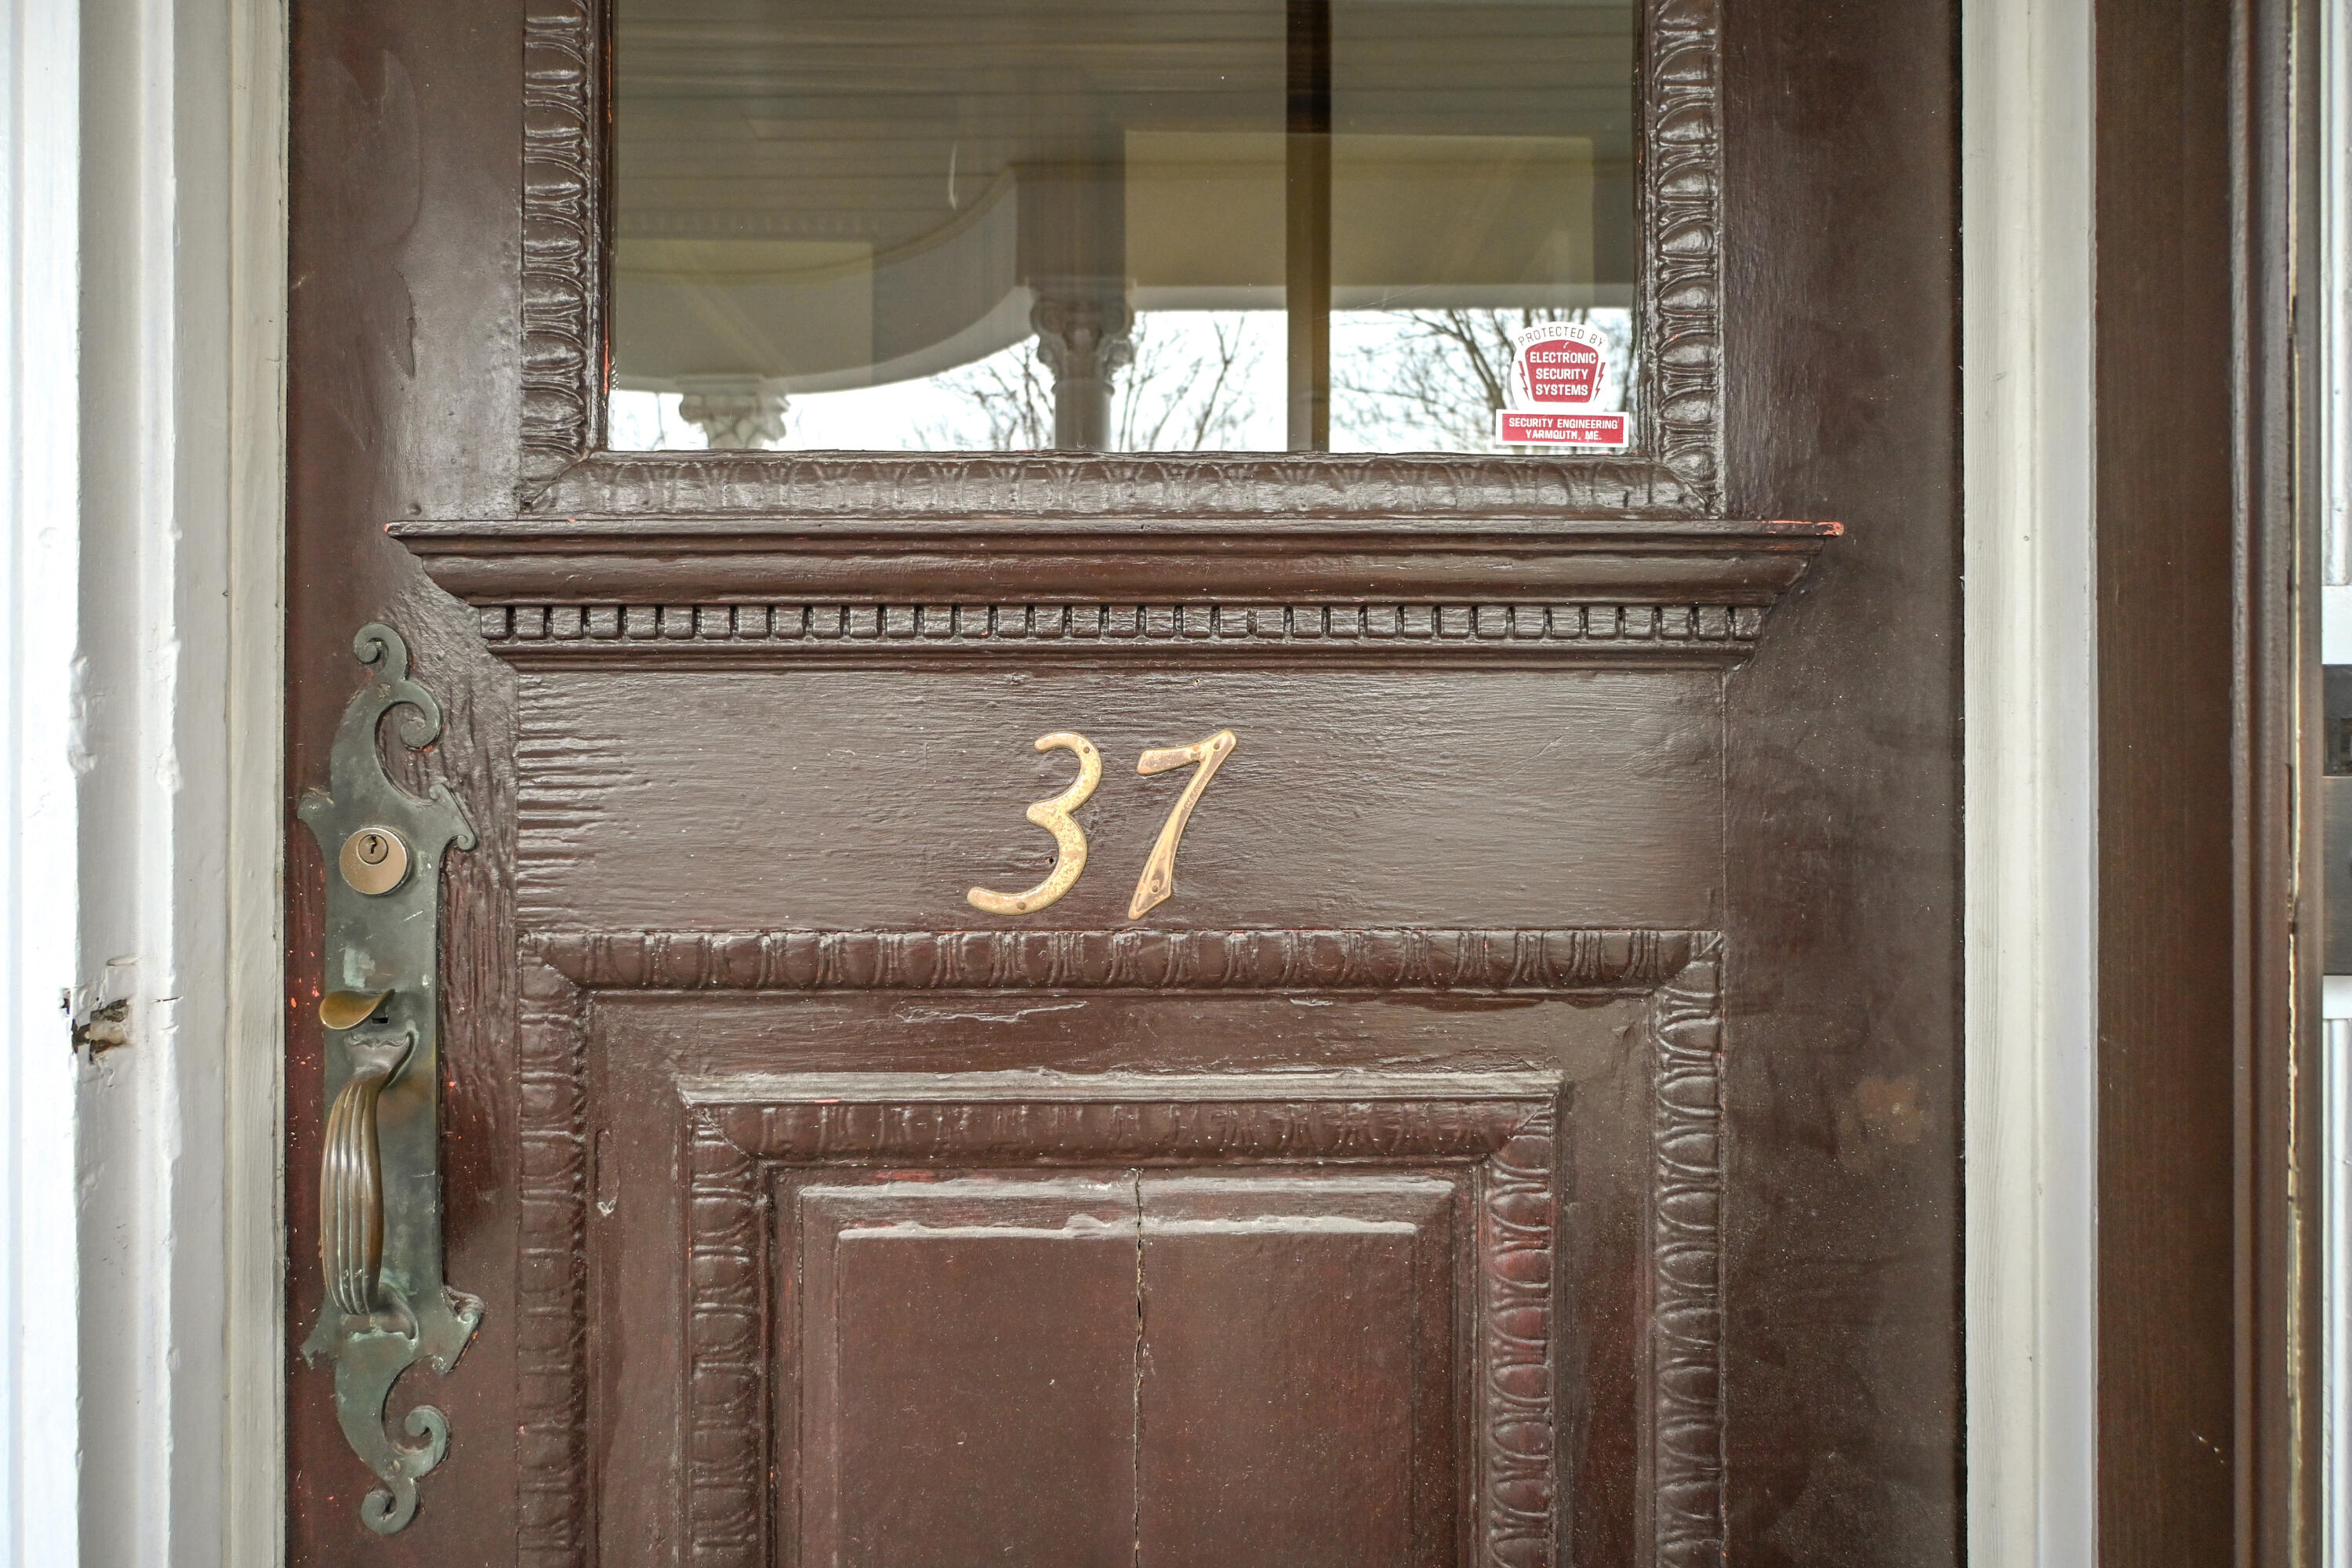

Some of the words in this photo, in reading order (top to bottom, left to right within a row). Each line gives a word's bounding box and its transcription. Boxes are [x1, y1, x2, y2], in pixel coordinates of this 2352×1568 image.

[1518, 326, 1584, 347] PROTECTED
[1589, 333, 1606, 347] BY
[1530, 351, 1597, 364] ELECTRONIC
[1535, 368, 1589, 380] SECURITY
[1535, 383, 1588, 396] SYSTEMS
[1508, 417, 1554, 428] SECURITY
[1557, 418, 1618, 430] ENGINEERING
[1525, 429, 1581, 441] YARMOUTH,
[1584, 430, 1602, 441] ME.
[966, 728, 1238, 920] 37
